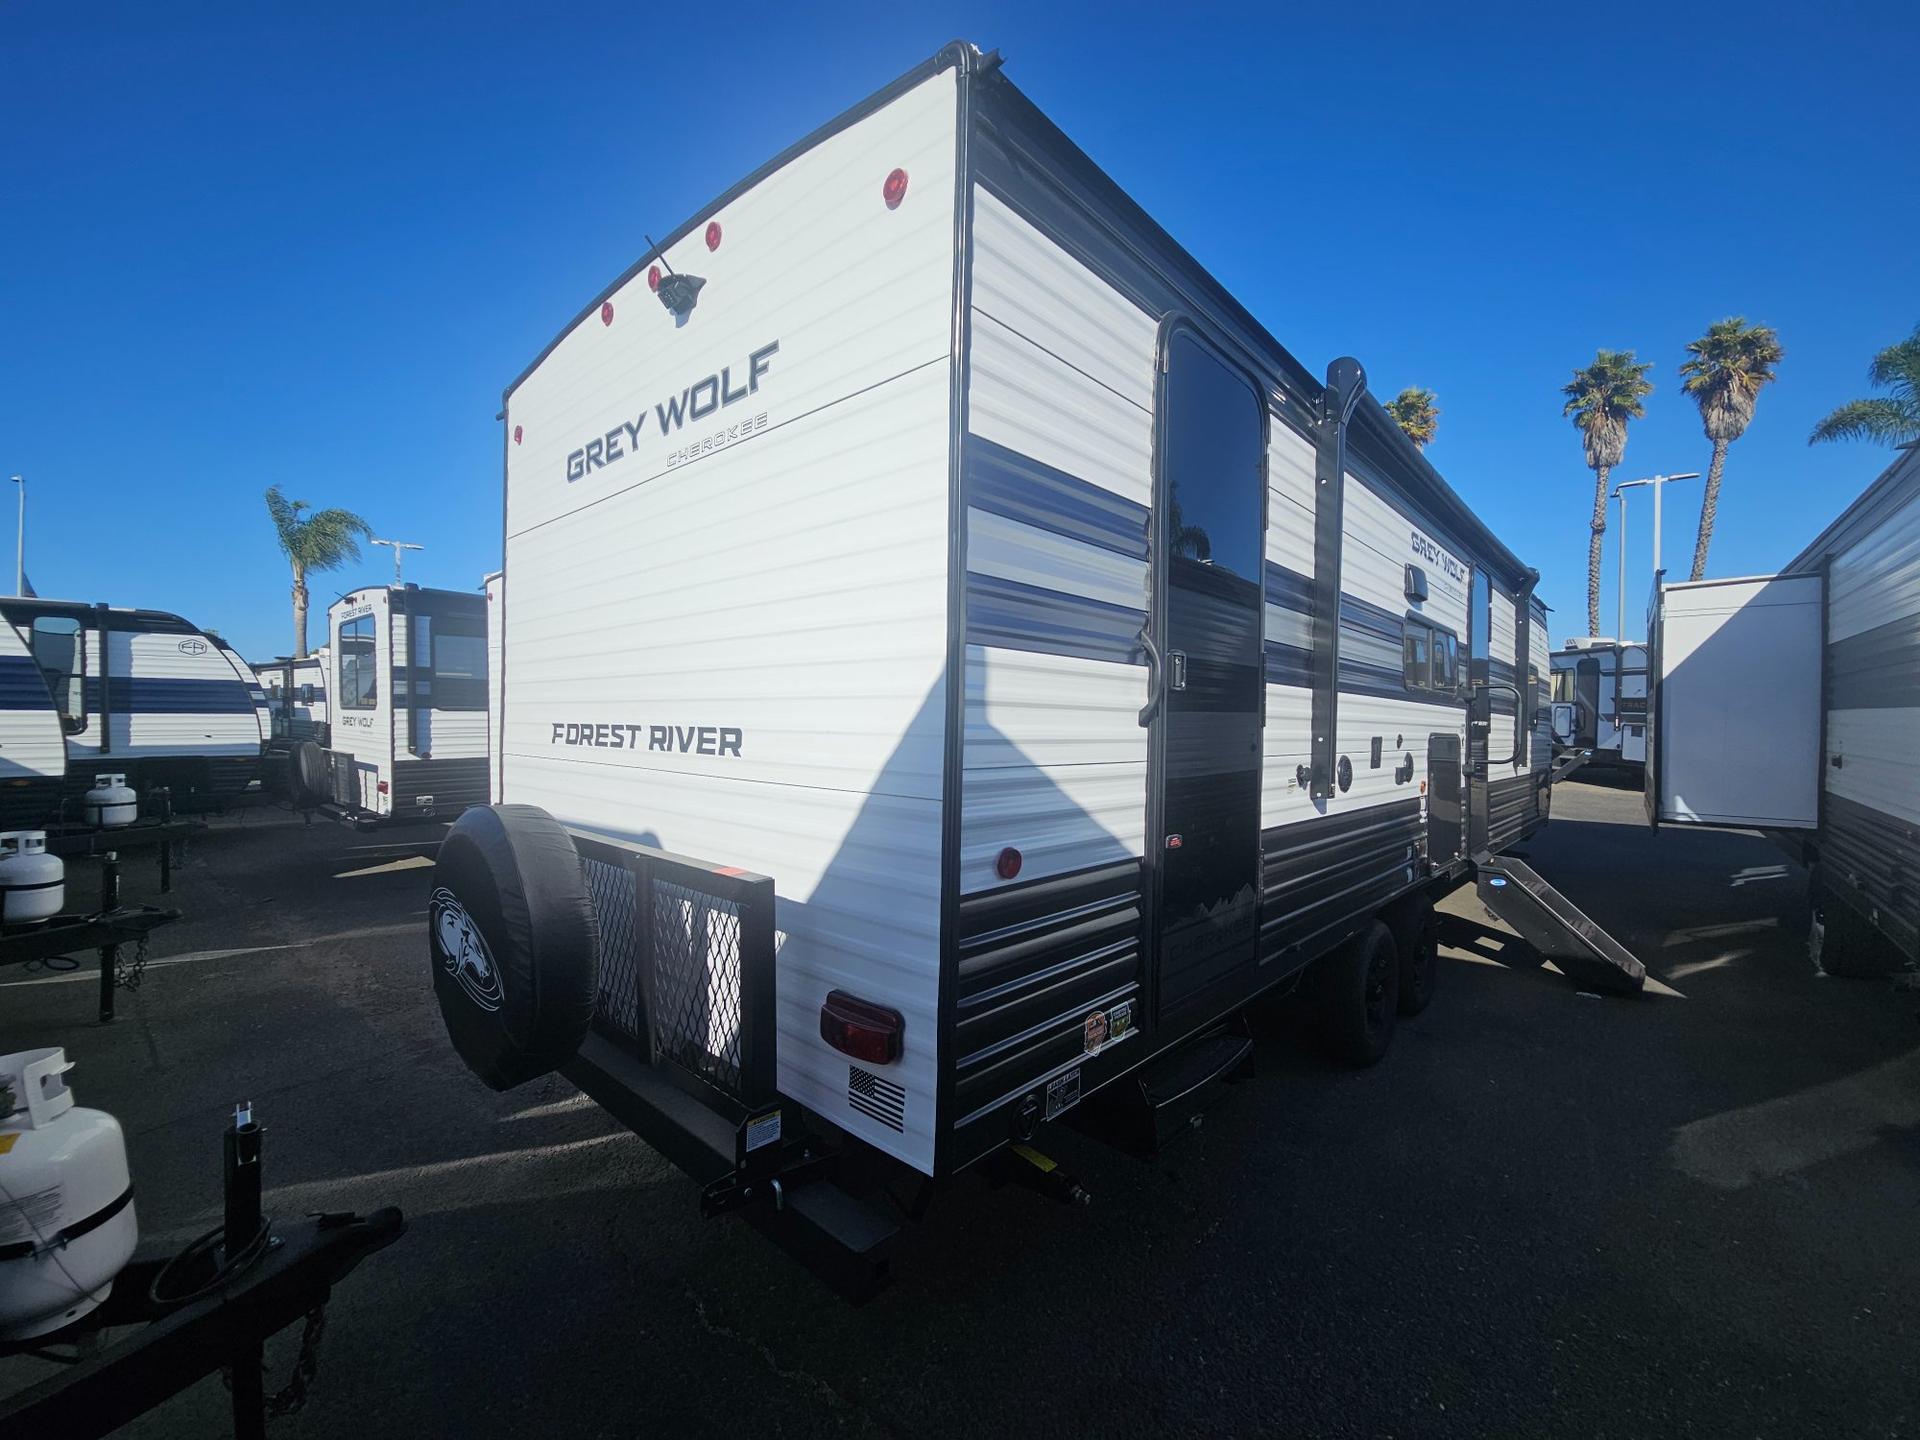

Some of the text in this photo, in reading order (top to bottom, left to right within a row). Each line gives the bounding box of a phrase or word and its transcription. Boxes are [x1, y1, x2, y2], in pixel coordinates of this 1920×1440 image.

[566, 338, 780, 484] GREY WOLF
[666, 411, 768, 468] CHEROKEE
[1411, 531, 1466, 585] GREY WOLF
[343, 716, 374, 728] GREY WOLF
[551, 723, 743, 758] FOREST RIVER
